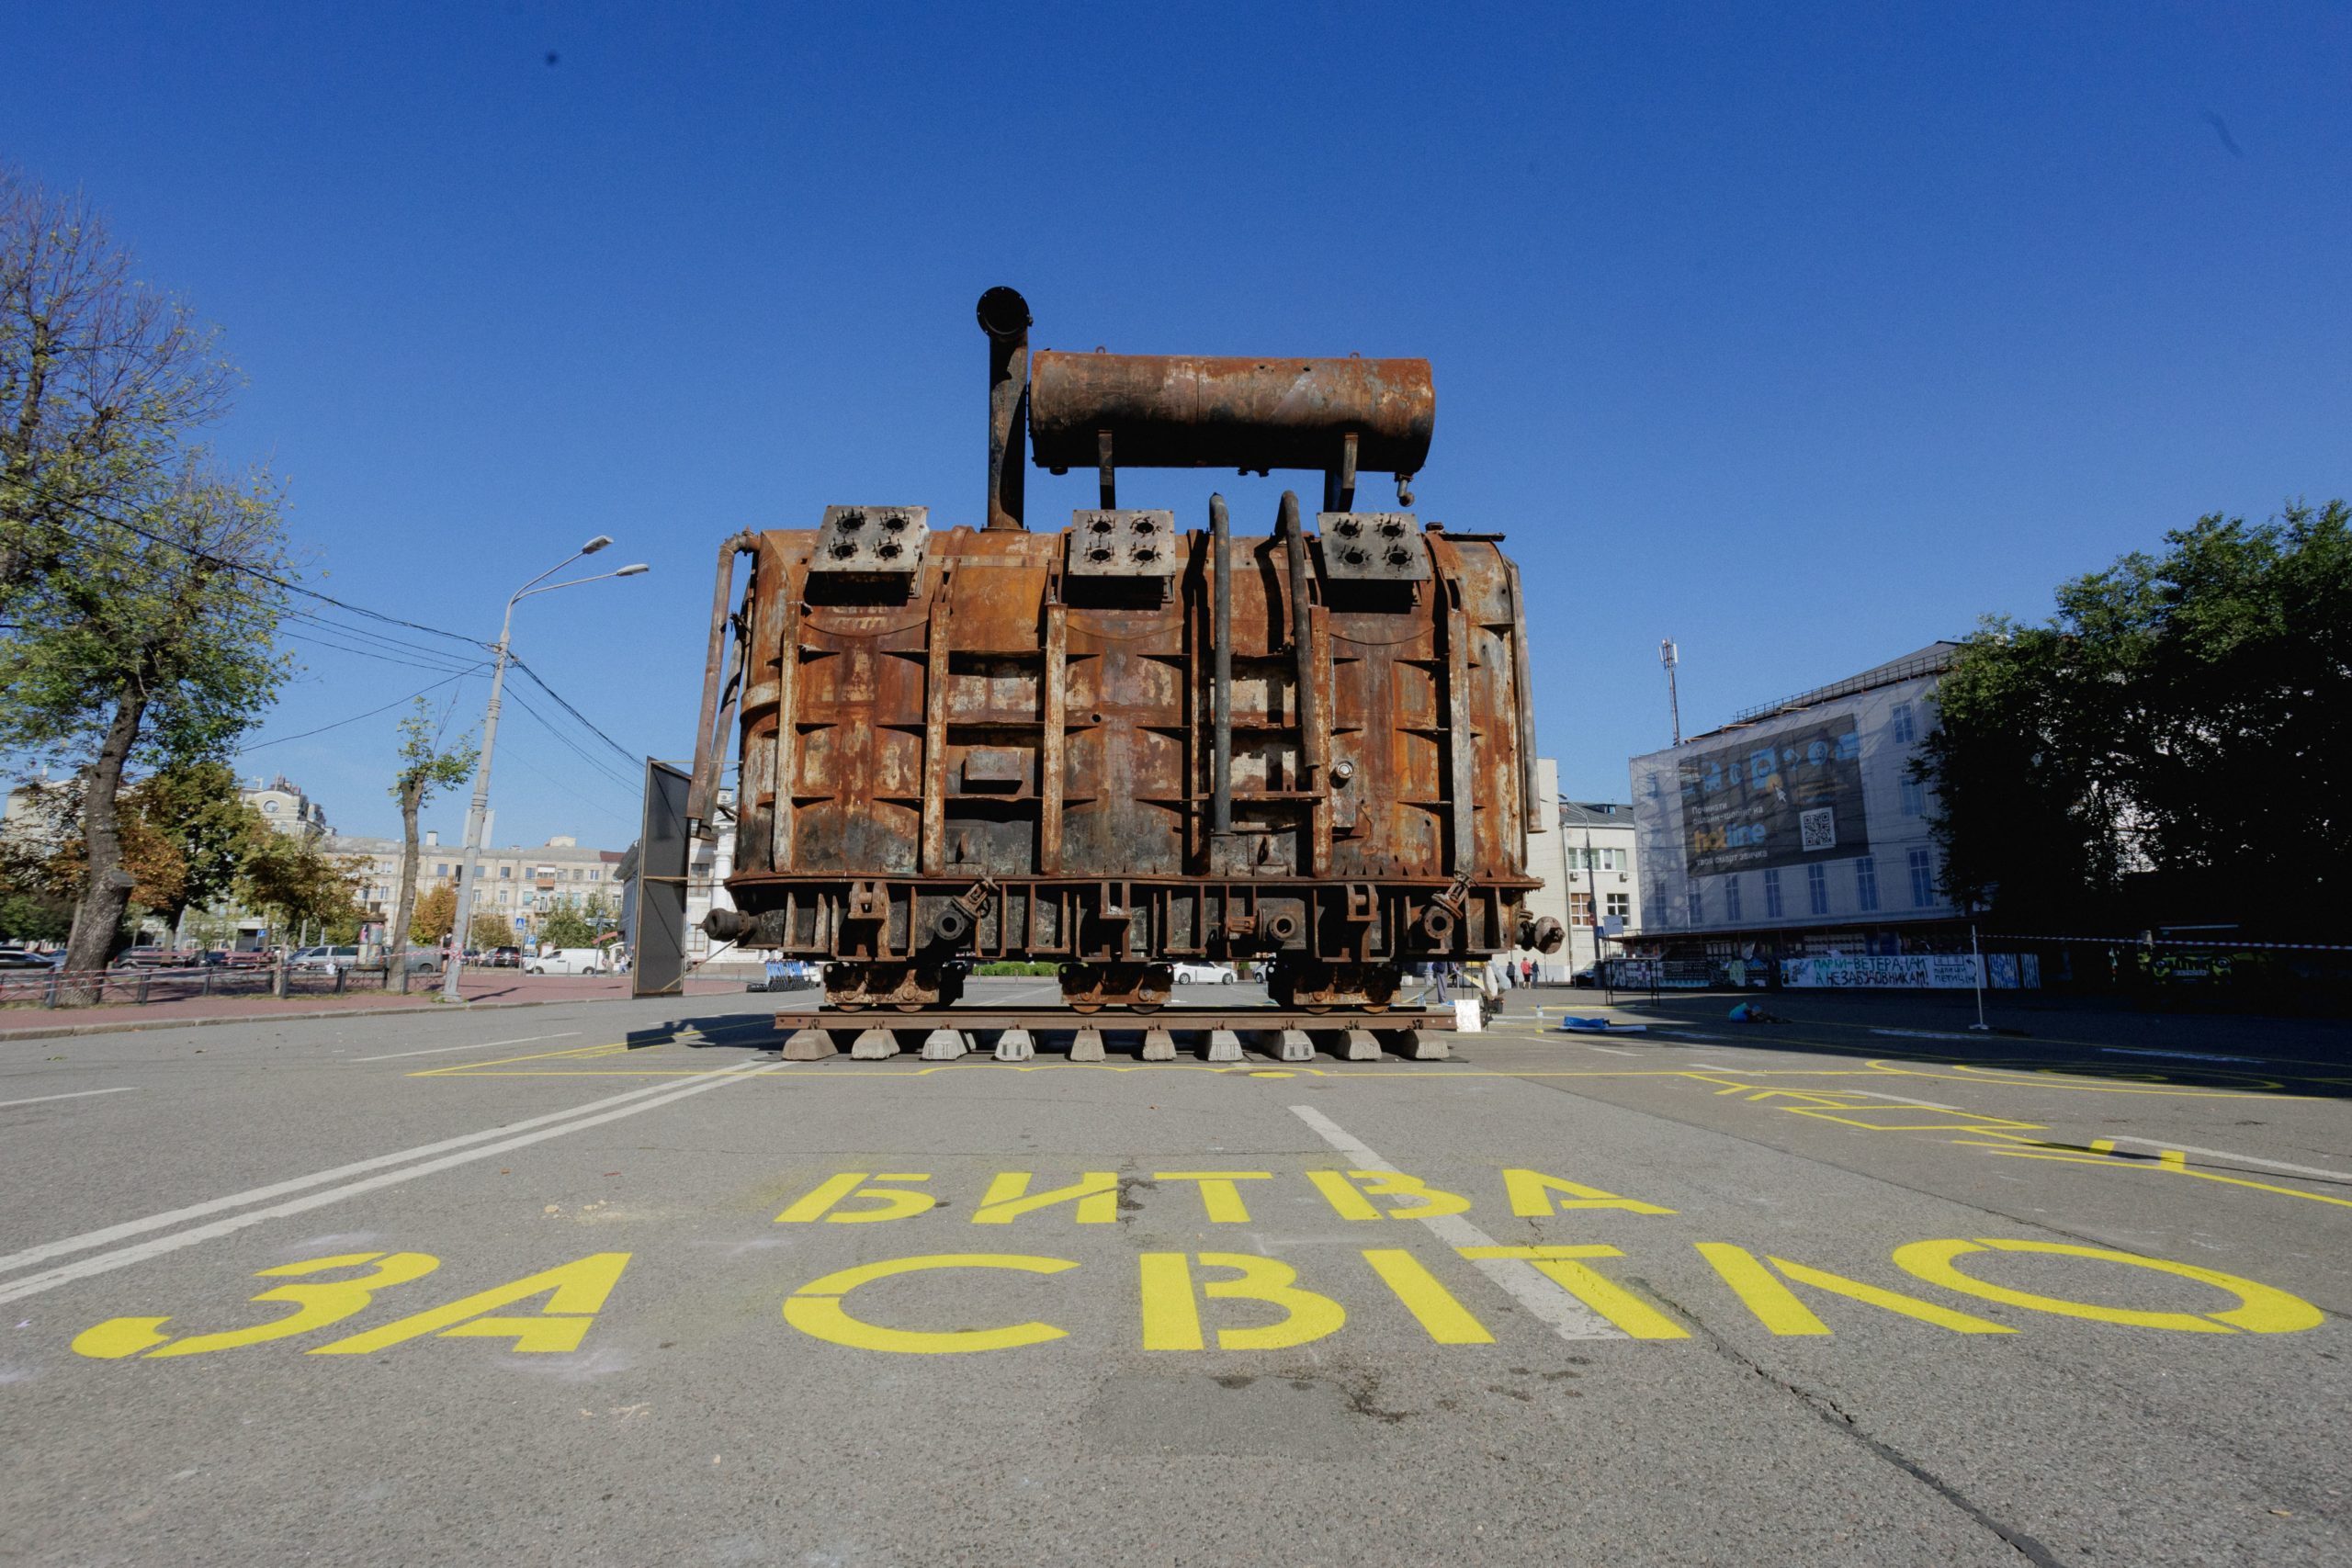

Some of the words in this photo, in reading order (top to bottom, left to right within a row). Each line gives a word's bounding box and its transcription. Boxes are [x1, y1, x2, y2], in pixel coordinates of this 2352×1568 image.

[1691, 803, 1727, 815] Починати
[1752, 807, 1764, 816] на
[1693, 823, 1766, 852] hotline
[1696, 858, 1714, 866] твоя
[1815, 971, 1825, 985] А
[775, 1169, 1677, 1225] БИТВА
[72, 1252, 632, 1359] ЗА
[783, 1237, 2325, 1354] СВІТЛО
